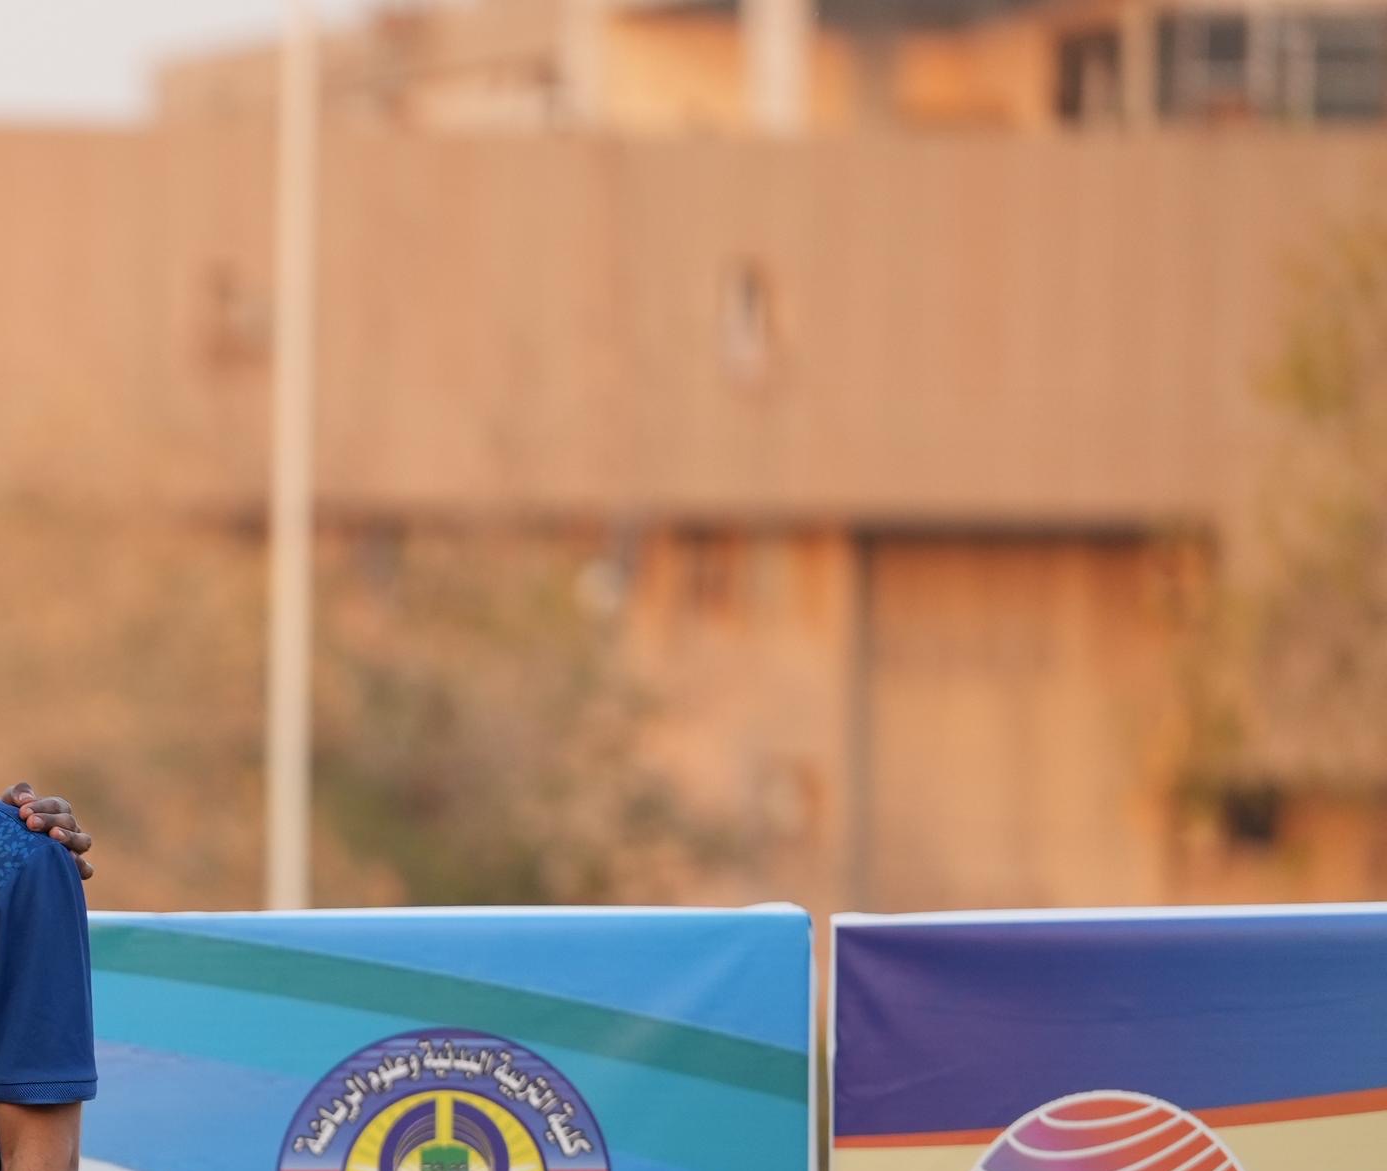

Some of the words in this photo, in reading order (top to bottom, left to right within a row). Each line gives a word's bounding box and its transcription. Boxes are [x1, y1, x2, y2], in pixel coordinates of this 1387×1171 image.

[367, 1053, 421, 1094] وعلوم
[418, 1040, 495, 1080] البدنية
[493, 1052, 559, 1114] التربية
[293, 1073, 371, 1157] الرياضة
[545, 1101, 593, 1157] كلية
